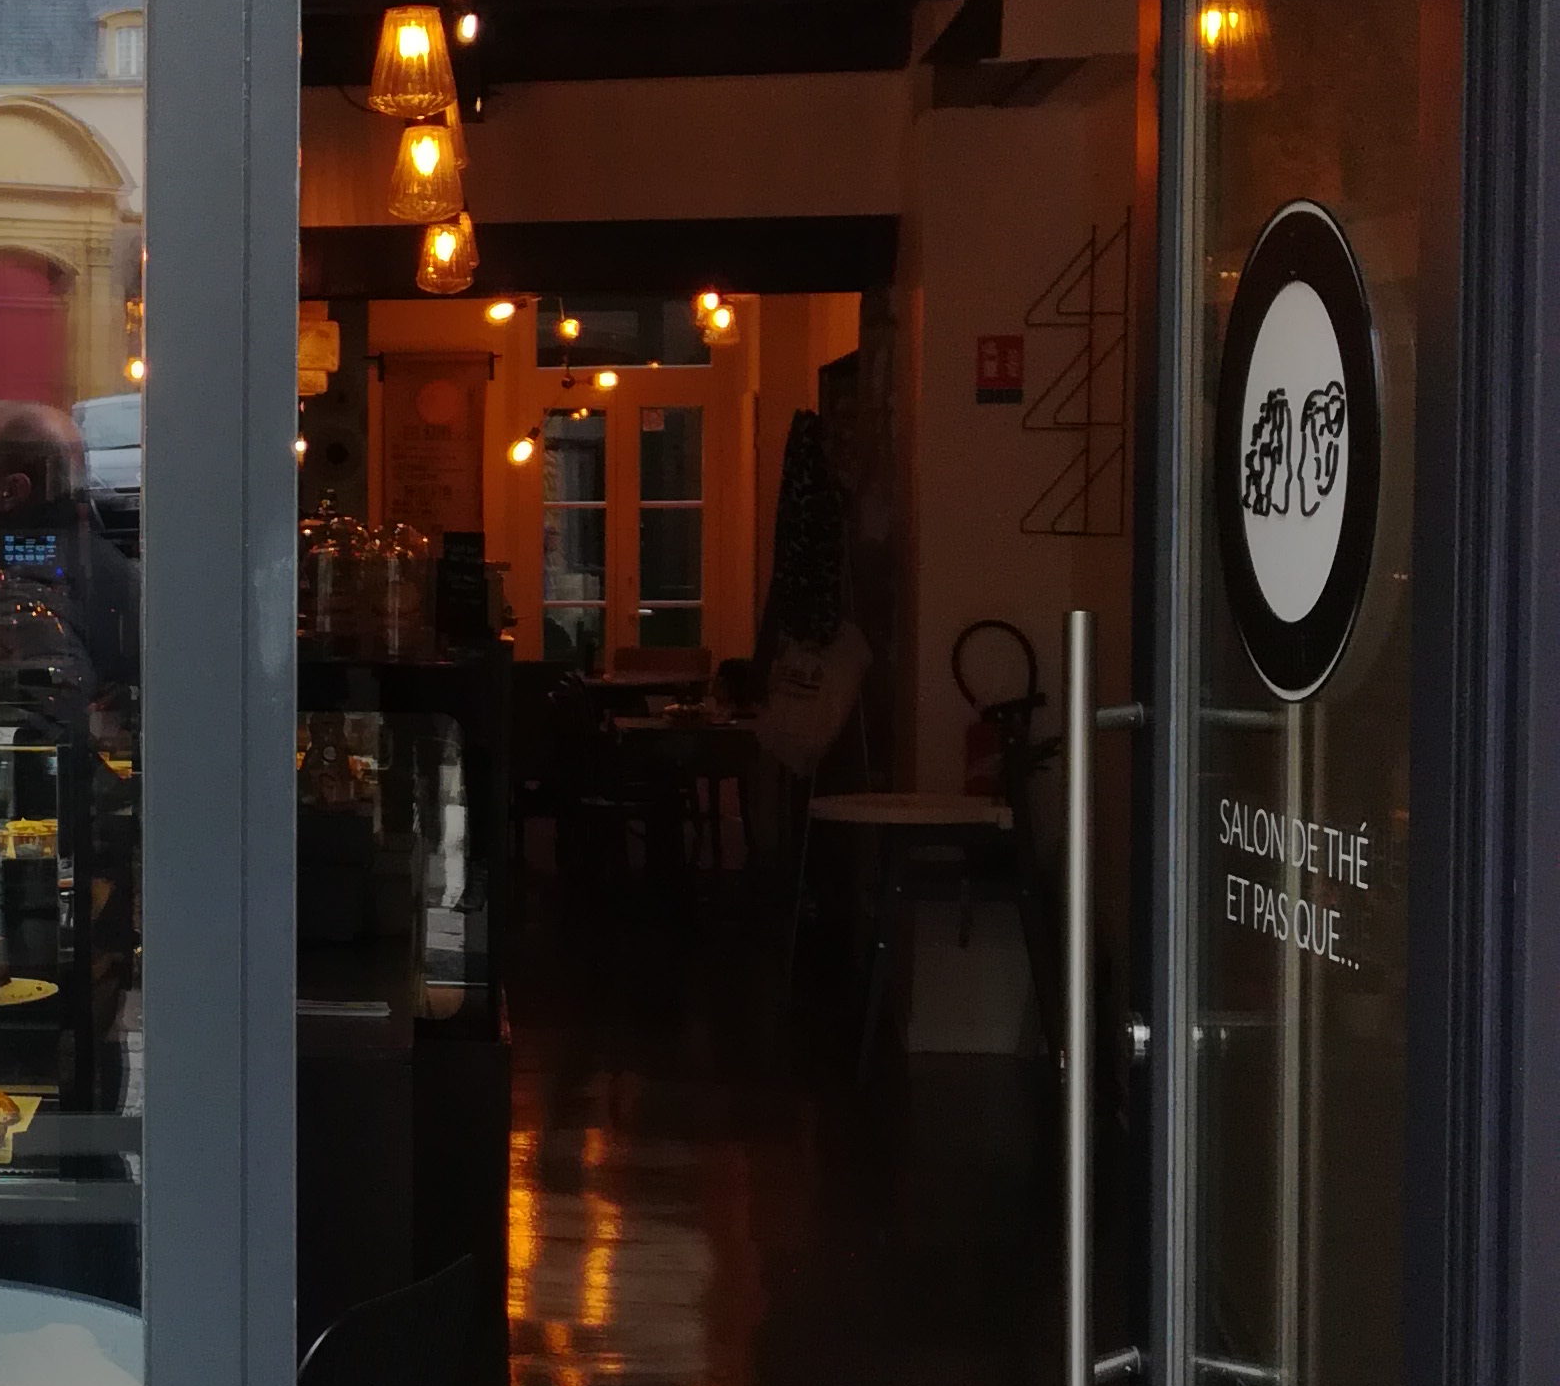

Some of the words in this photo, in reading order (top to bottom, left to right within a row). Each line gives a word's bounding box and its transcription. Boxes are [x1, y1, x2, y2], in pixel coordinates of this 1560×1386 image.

[1219, 798, 1285, 863] SALON
[1291, 818, 1319, 874] DE
[1323, 821, 1369, 890] THÉ
[1226, 874, 1250, 924] ET
[1253, 883, 1289, 941] PAS
[1293, 899, 1360, 971] QUE...
